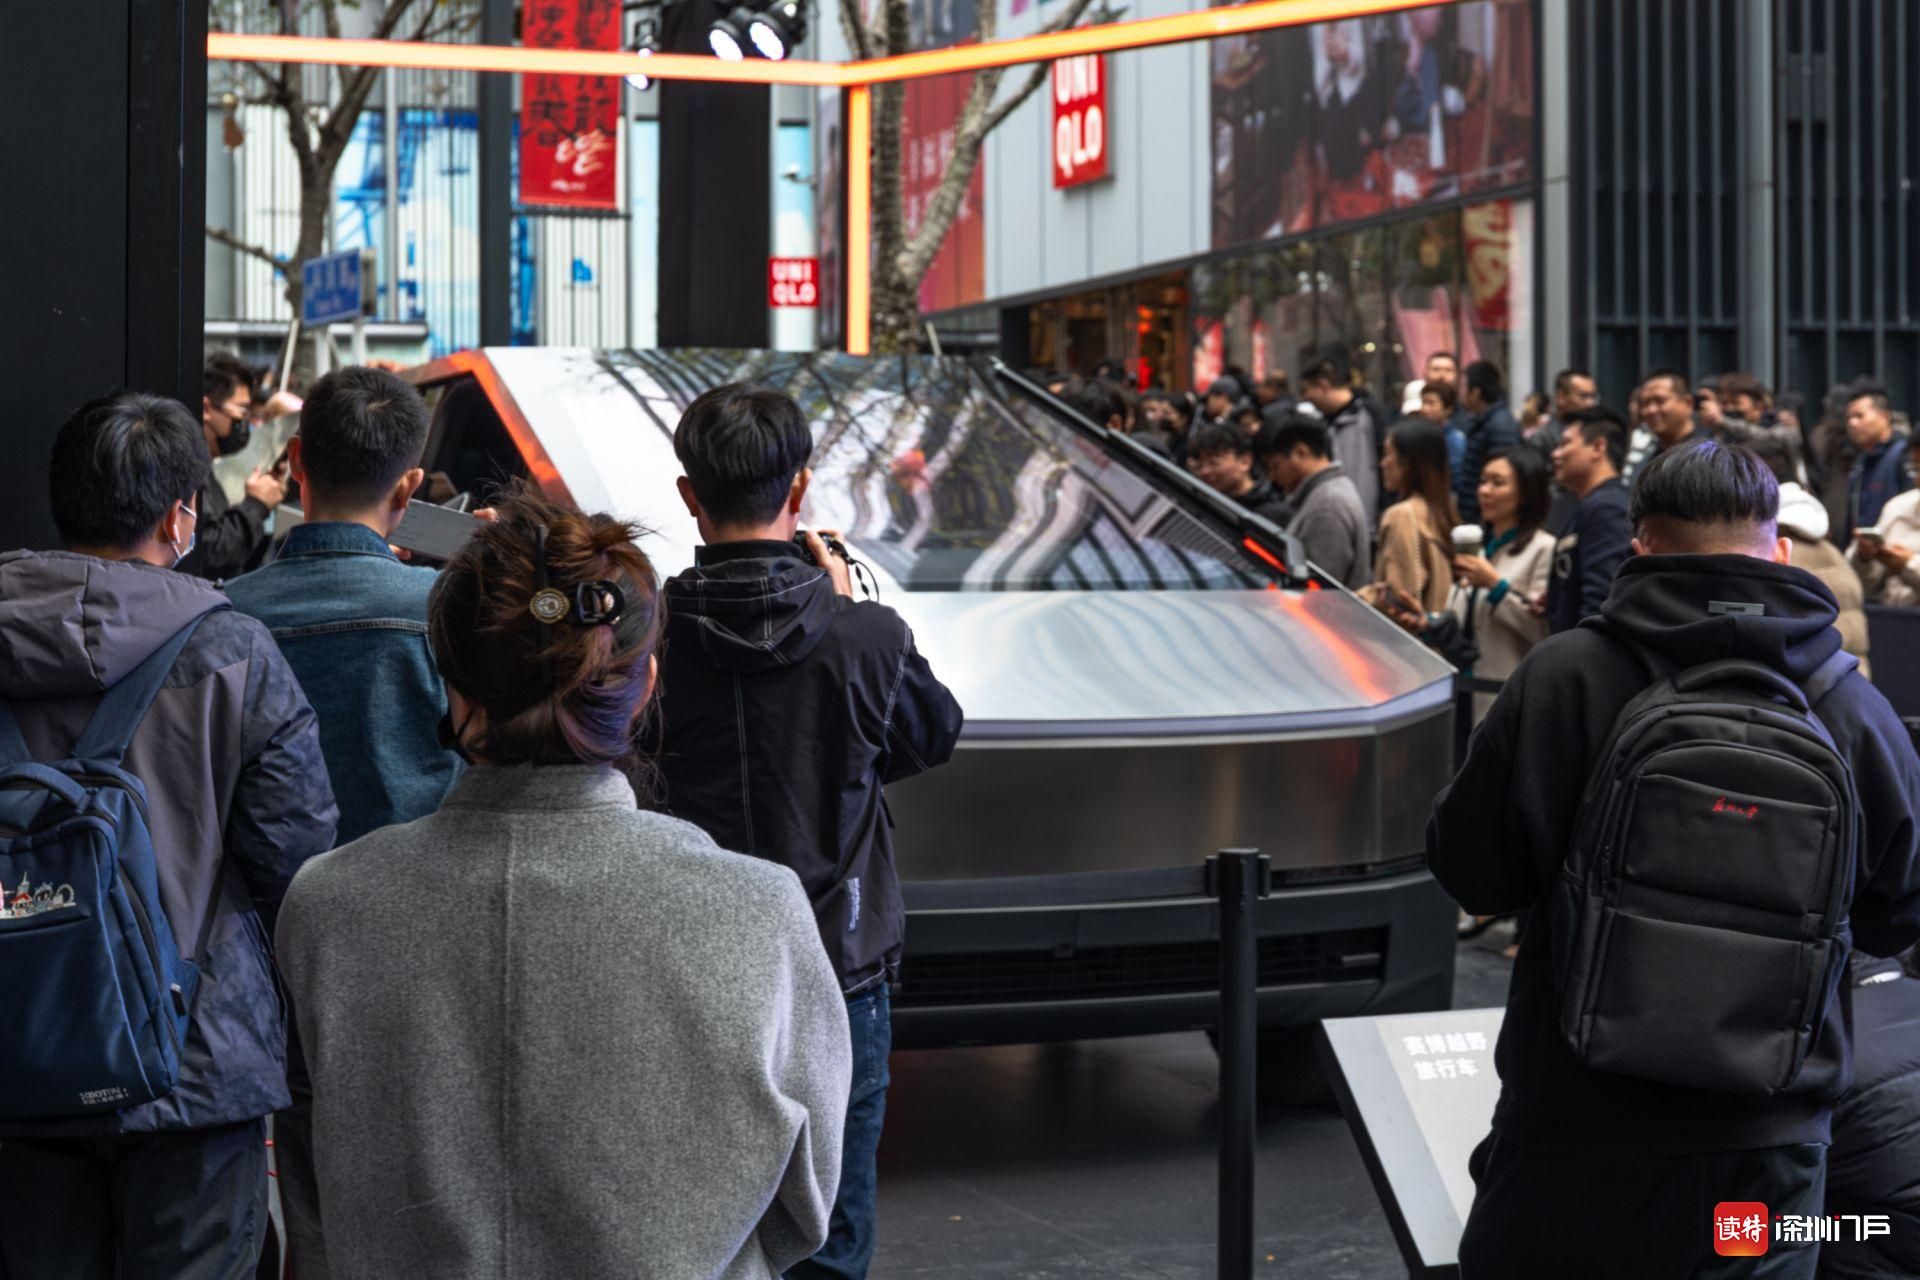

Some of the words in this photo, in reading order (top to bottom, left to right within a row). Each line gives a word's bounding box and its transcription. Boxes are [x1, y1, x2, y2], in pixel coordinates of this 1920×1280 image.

[1056, 55, 1099, 105] UNI
[1056, 105, 1103, 178] QLO
[772, 260, 813, 281] UNI
[772, 281, 817, 305] QLO
[1402, 1031, 1488, 1056] 赛博越野
[1413, 1057, 1479, 1080] 旅行车
